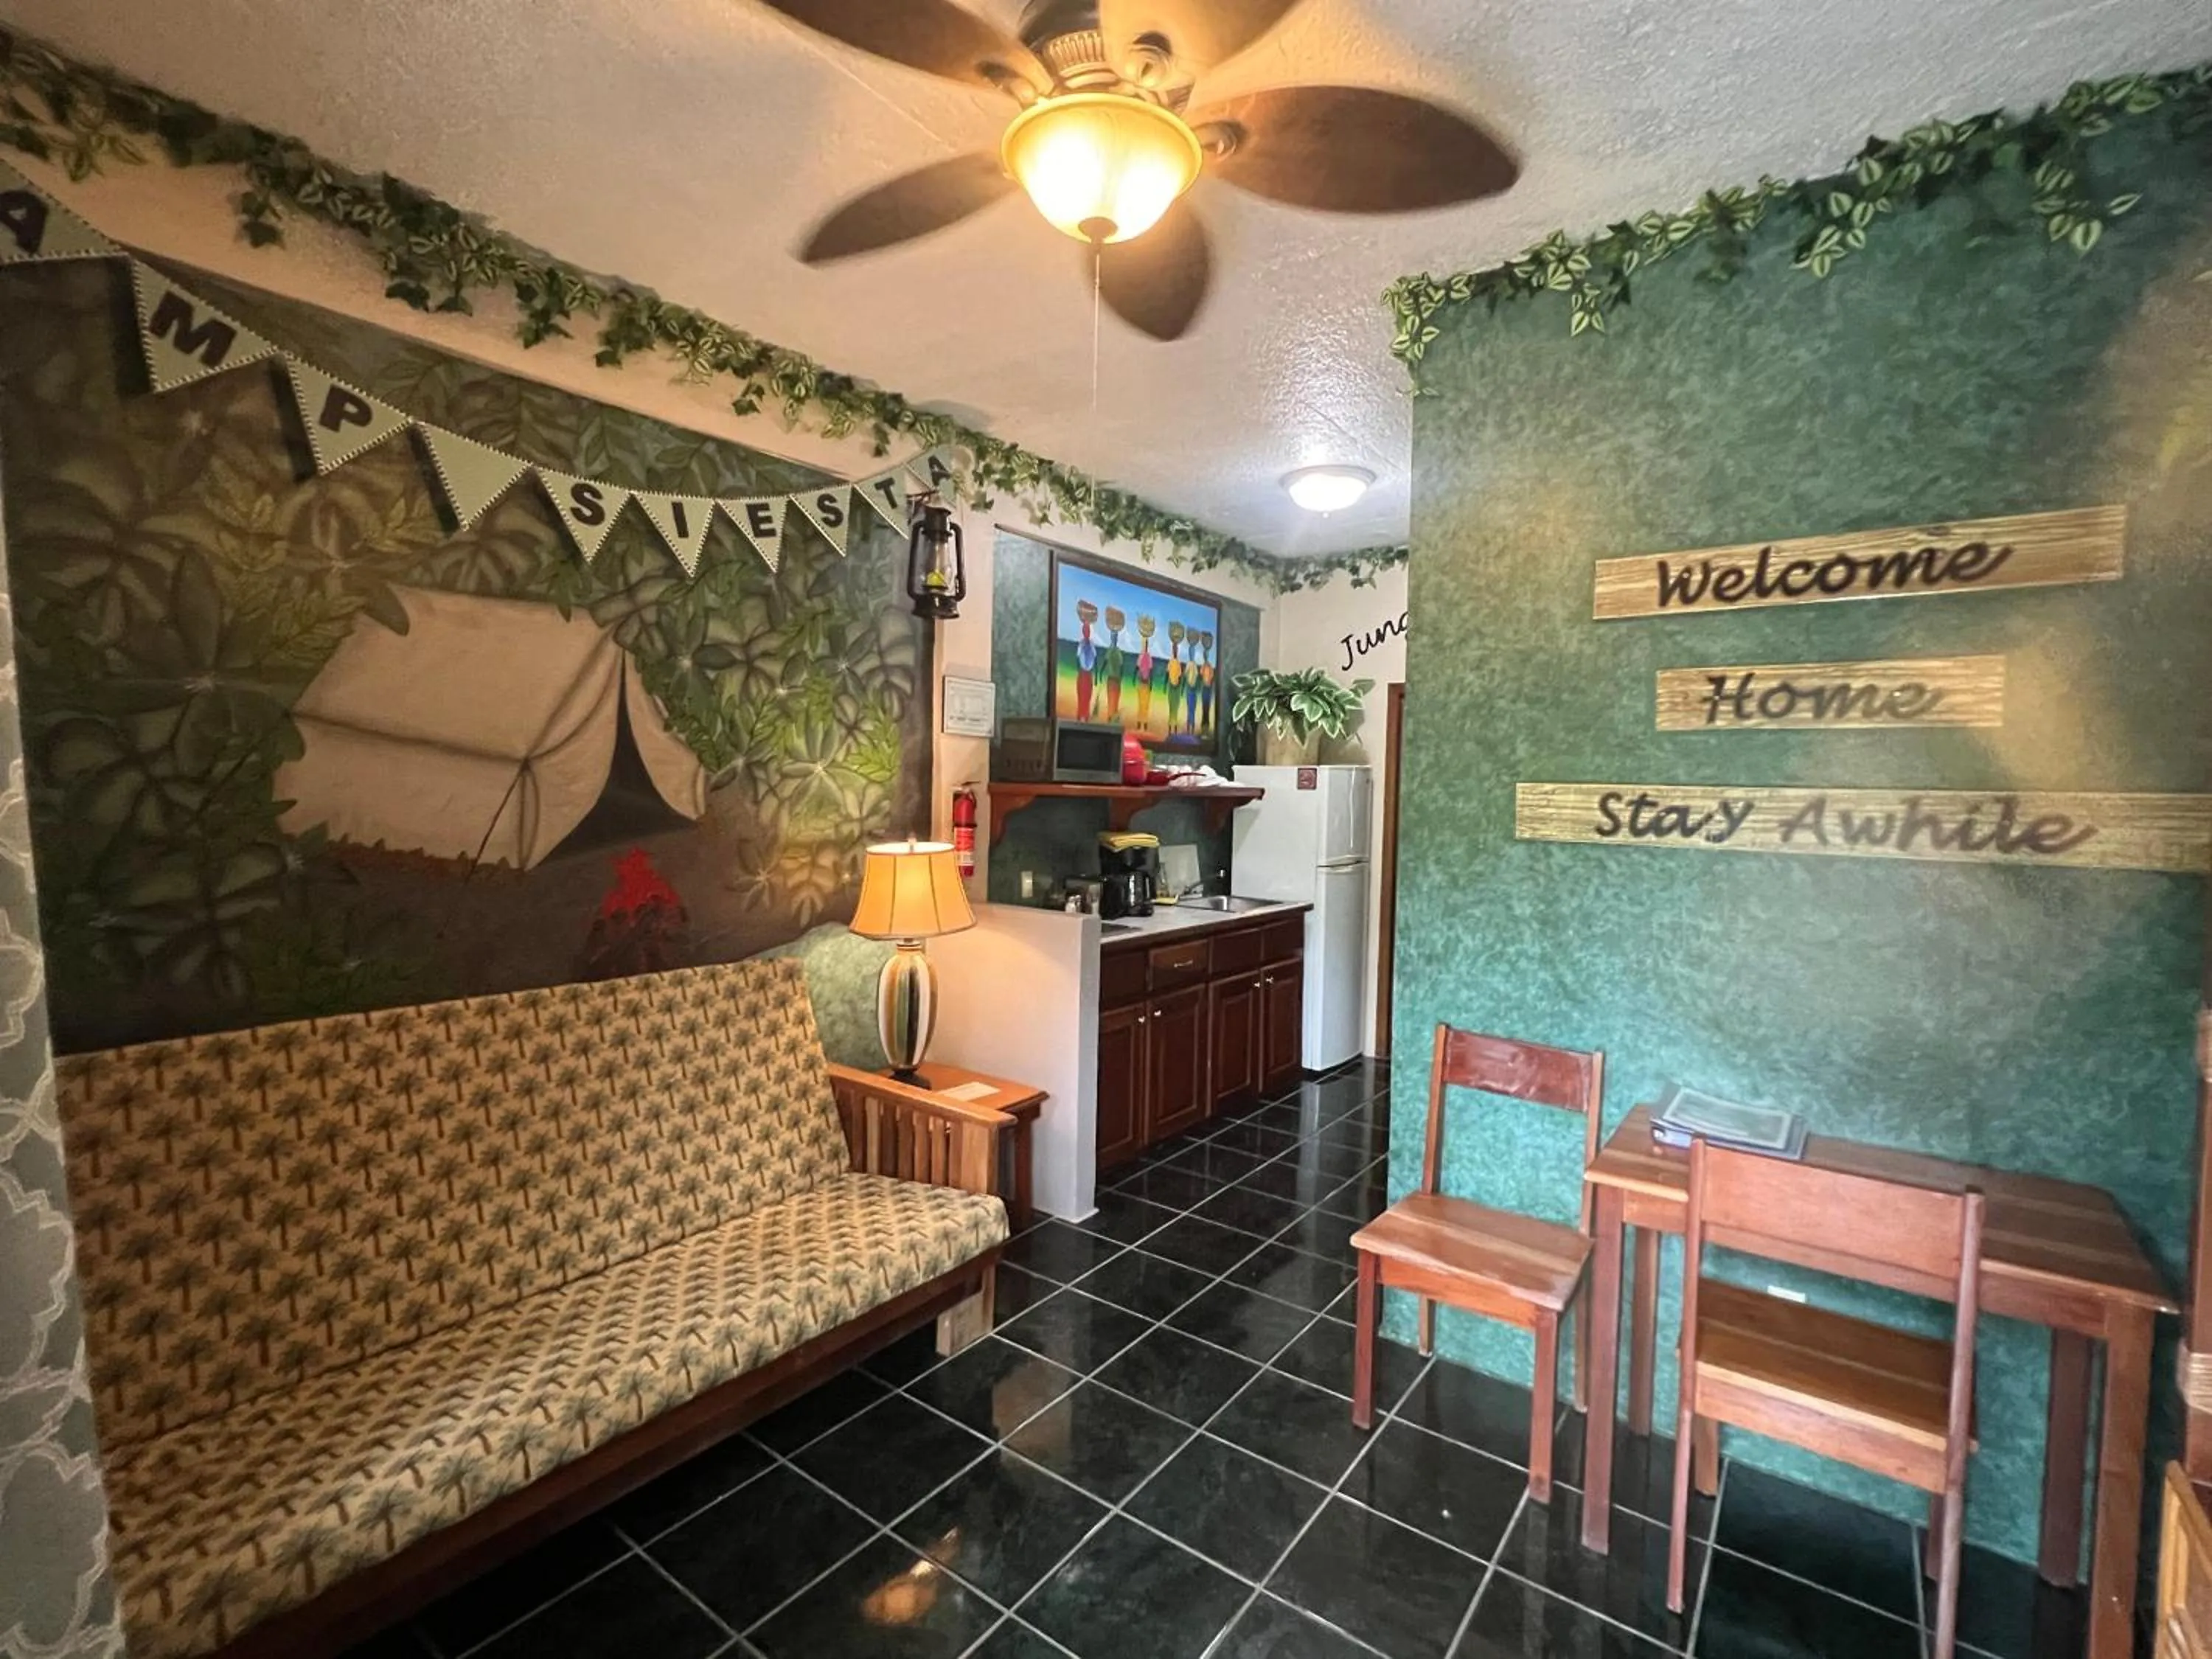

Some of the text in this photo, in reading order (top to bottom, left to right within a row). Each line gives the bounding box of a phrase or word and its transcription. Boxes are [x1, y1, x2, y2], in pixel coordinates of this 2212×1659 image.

[570, 455, 951, 538] SIESTA
[1656, 540, 2017, 607] Welcome
[1700, 672, 1943, 725] Home
[1594, 790, 2099, 855] Stay Awhile
